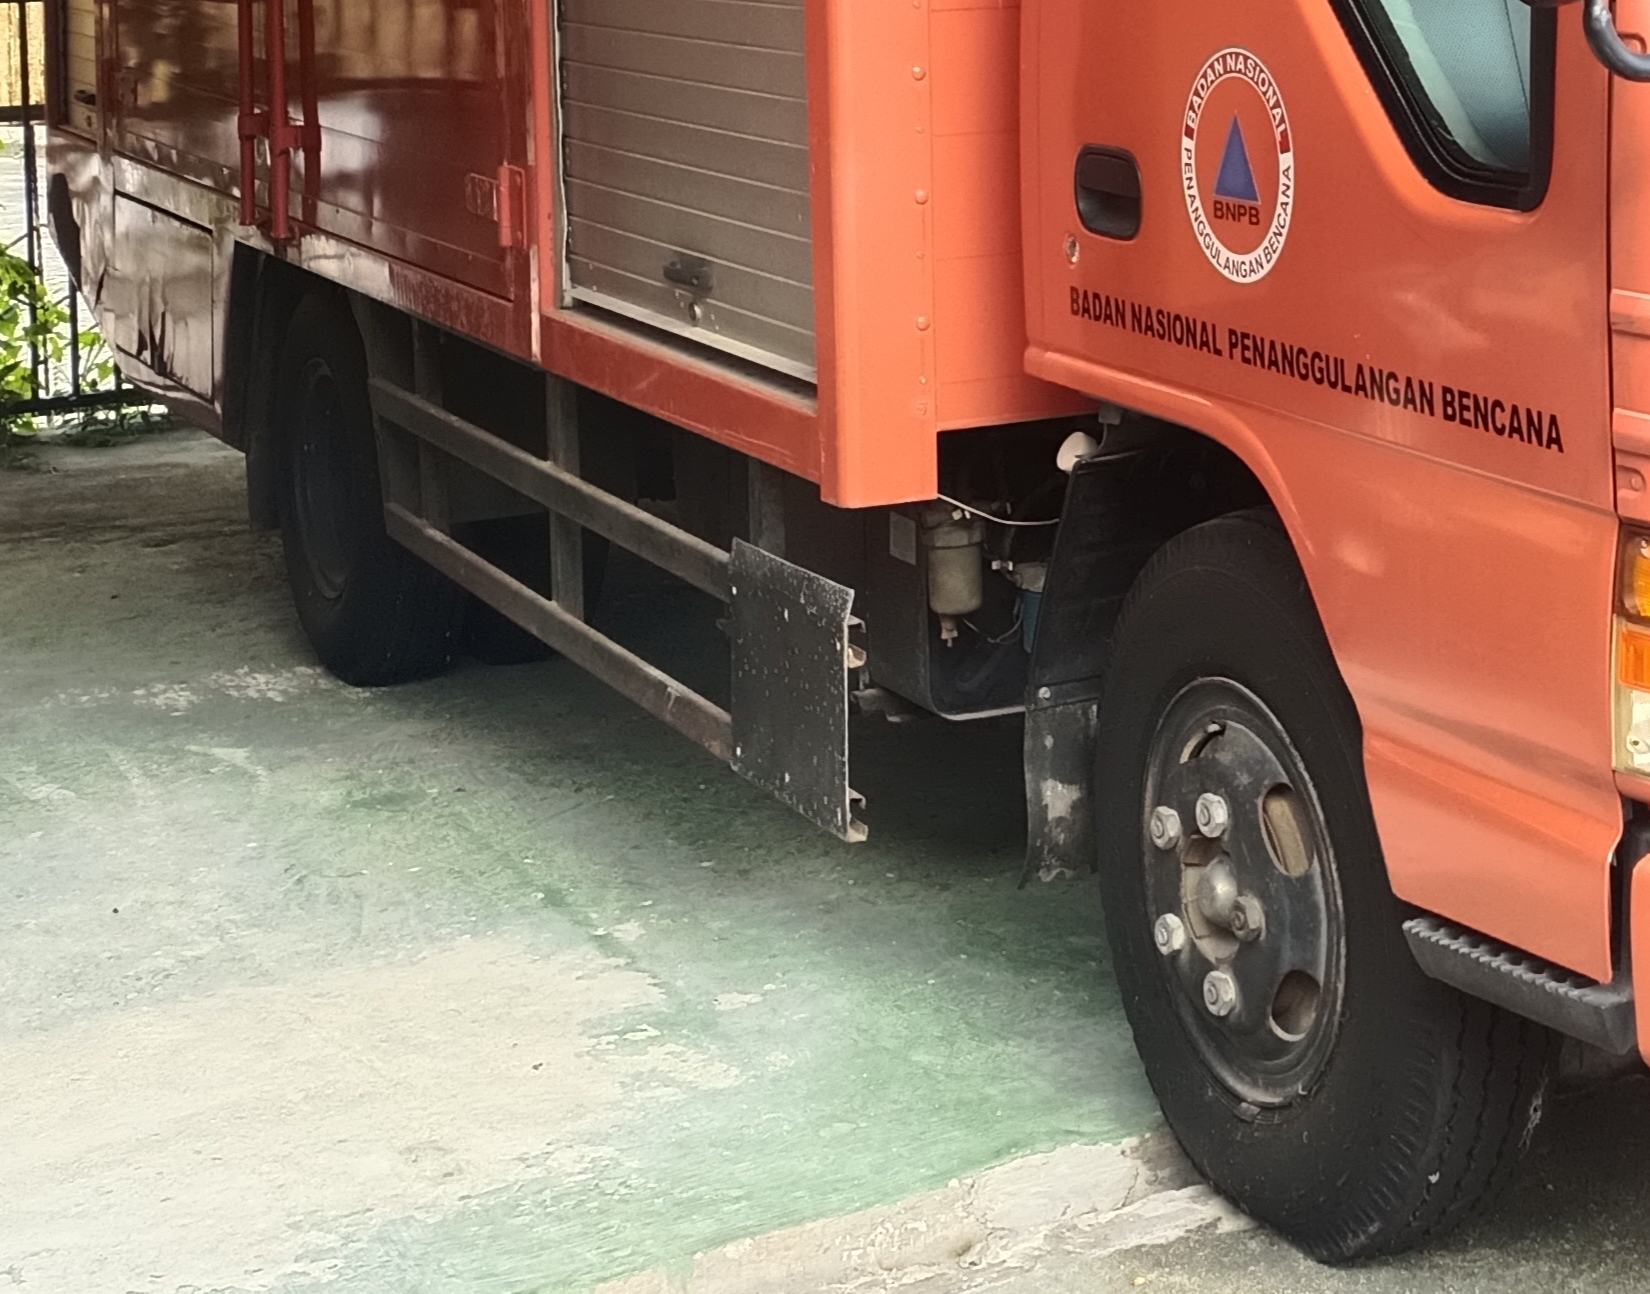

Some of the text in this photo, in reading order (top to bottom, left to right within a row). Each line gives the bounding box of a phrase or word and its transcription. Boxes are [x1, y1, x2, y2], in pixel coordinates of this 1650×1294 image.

[1186, 53, 1287, 141] BADAN NASIONAL
[1183, 146, 1292, 279] PENANGGULANGAN BENCANA
[1213, 200, 1261, 226] BNPB
[1069, 285, 1565, 454] BADAN NASIONAL PENANGGULANGAN BENCANA
